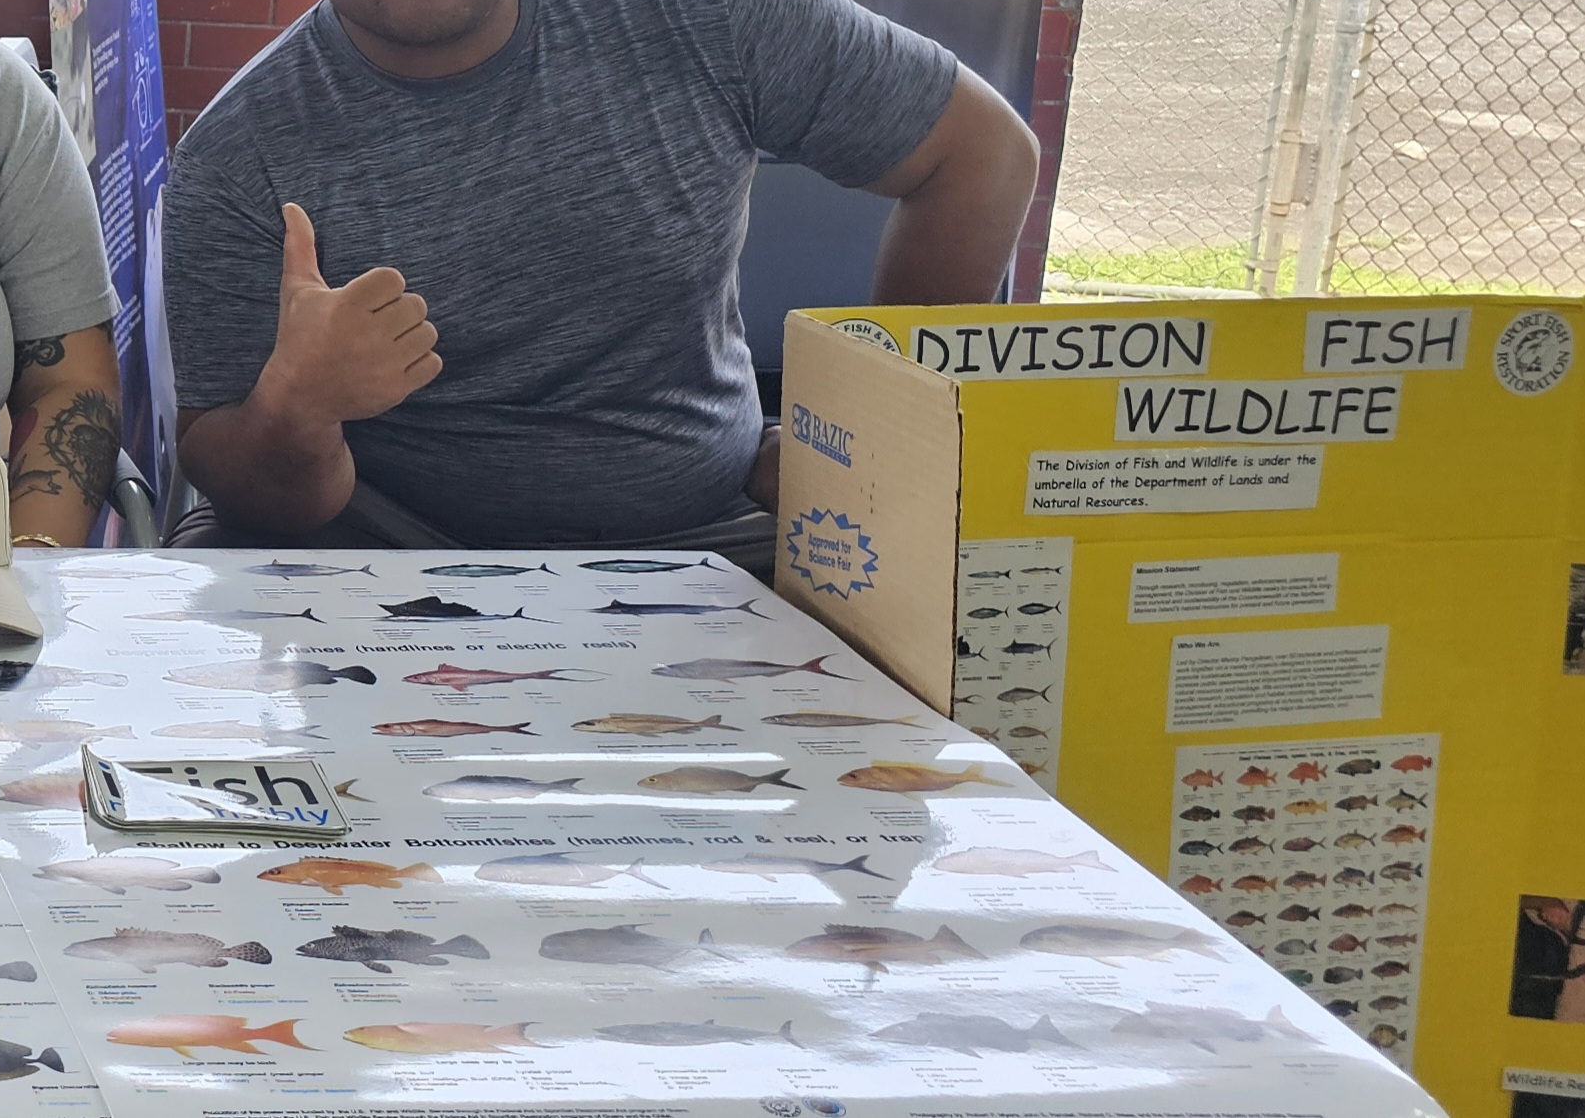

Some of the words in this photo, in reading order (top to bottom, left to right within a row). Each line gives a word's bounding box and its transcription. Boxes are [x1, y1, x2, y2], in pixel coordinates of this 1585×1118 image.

[844, 323, 872, 335] FISH
[1500, 313, 1542, 346] SPORT
[1543, 314, 1571, 345] FISH
[917, 321, 1205, 373] DIVISION
[1320, 316, 1458, 368] FISH
[1497, 350, 1571, 393] RESTORATION
[1124, 385, 1396, 435] WILDLIFE
[813, 413, 853, 457] BAZIC
[1036, 460, 1060, 472] The
[1066, 458, 1110, 471] Division
[1115, 458, 1128, 470] of
[1133, 457, 1159, 470] Fish
[1165, 457, 1186, 469] and
[1191, 456, 1238, 469] Wildlife
[1243, 455, 1253, 467] is
[1258, 455, 1292, 467] under
[1297, 454, 1316, 466] the
[1035, 478, 1087, 490] umbrella
[1092, 477, 1105, 489] of
[1110, 476, 1129, 489] the
[1134, 476, 1208, 490] Department
[1212, 474, 1225, 486] of
[1229, 474, 1263, 486] Lands
[1267, 473, 1289, 485] and
[1033, 496, 1080, 509] Natural
[1086, 496, 1148, 509] Resources.
[808, 533, 841, 553] Approved
[841, 543, 851, 555] for
[808, 550, 836, 568] Science
[837, 556, 852, 572] Fair
[355, 643, 456, 654] (handlines
[466, 644, 484, 653] or
[496, 642, 568, 652] electric
[97, 761, 320, 806] iish
[238, 840, 261, 849] to
[272, 839, 392, 850] Deepwater
[404, 836, 556, 849] Bottomfishes
[568, 835, 694, 847] (handlines,
[703, 835, 742, 845] rod
[755, 836, 773, 844] &
[784, 834, 835, 846] reel,
[845, 835, 869, 844] or
